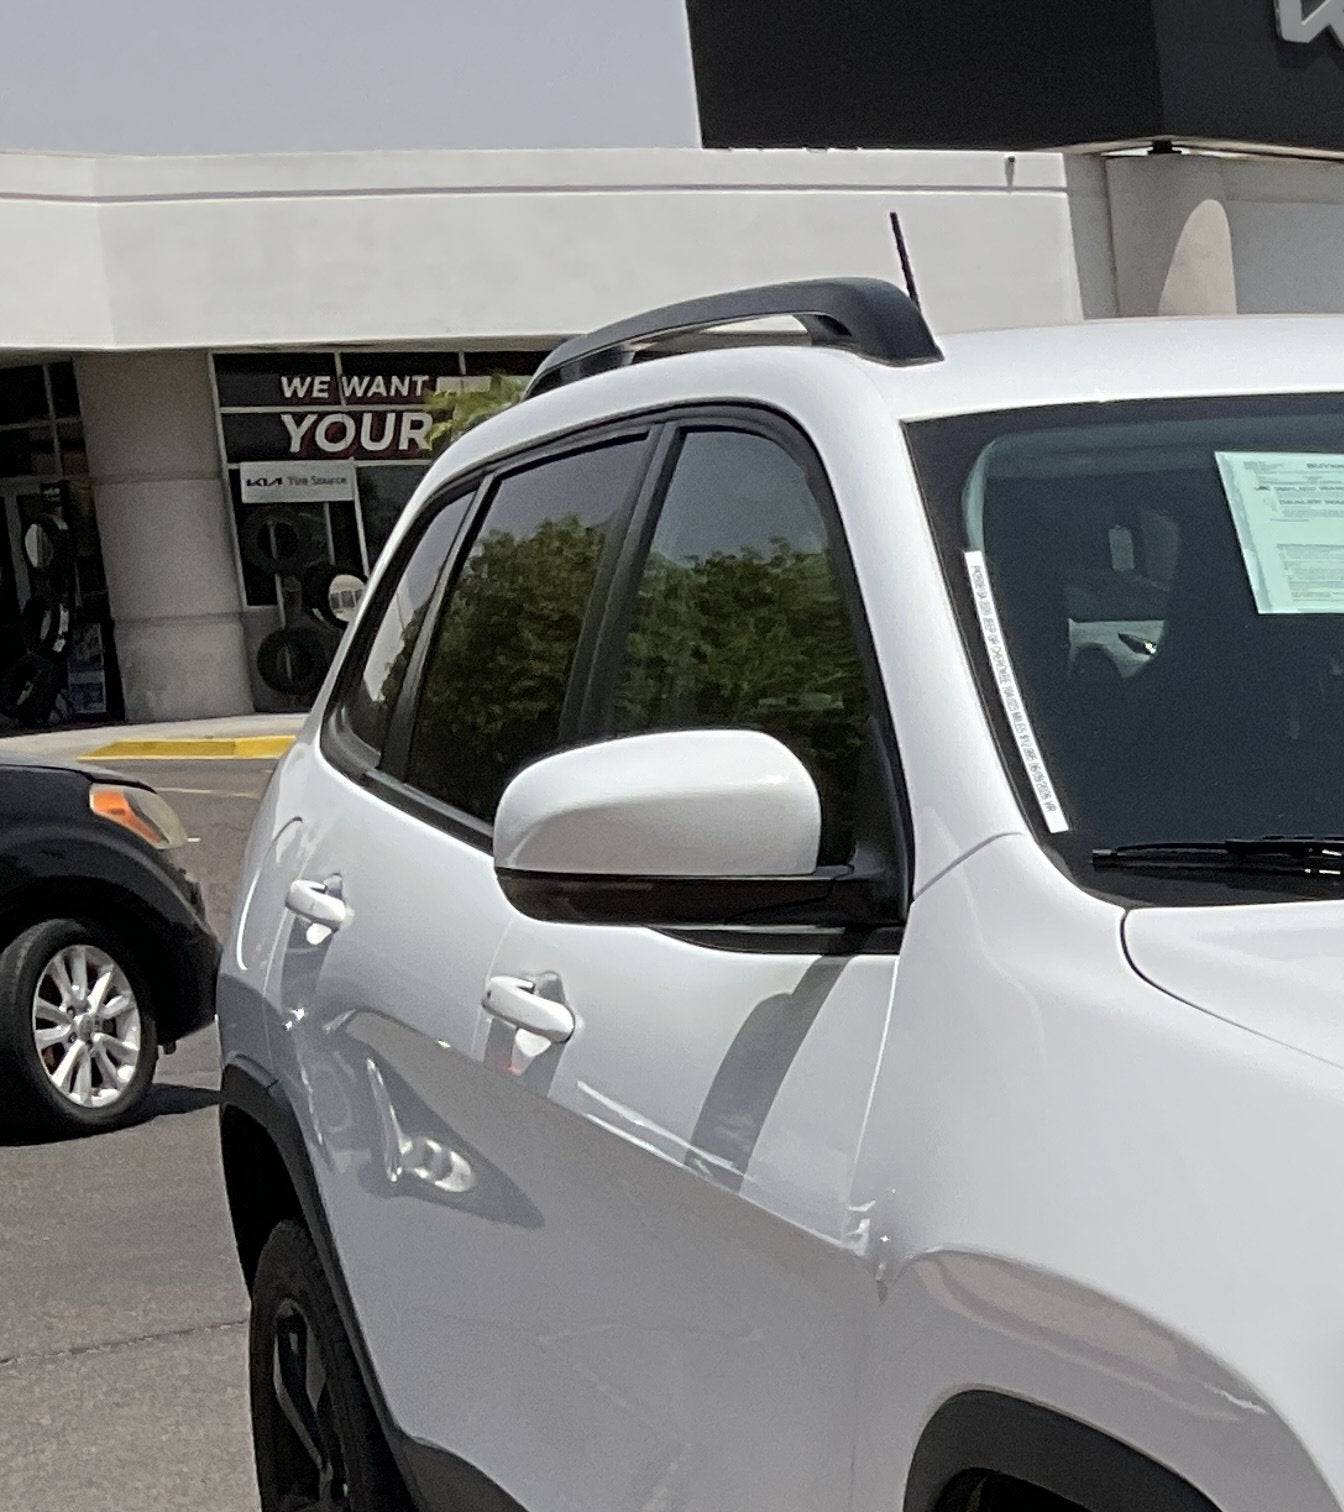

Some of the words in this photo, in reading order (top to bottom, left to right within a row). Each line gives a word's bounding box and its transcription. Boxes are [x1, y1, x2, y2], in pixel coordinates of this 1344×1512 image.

[280, 375, 331, 399] WE
[341, 374, 430, 398] WANT
[280, 411, 435, 453] YOUR
[246, 477, 283, 487] KIA
